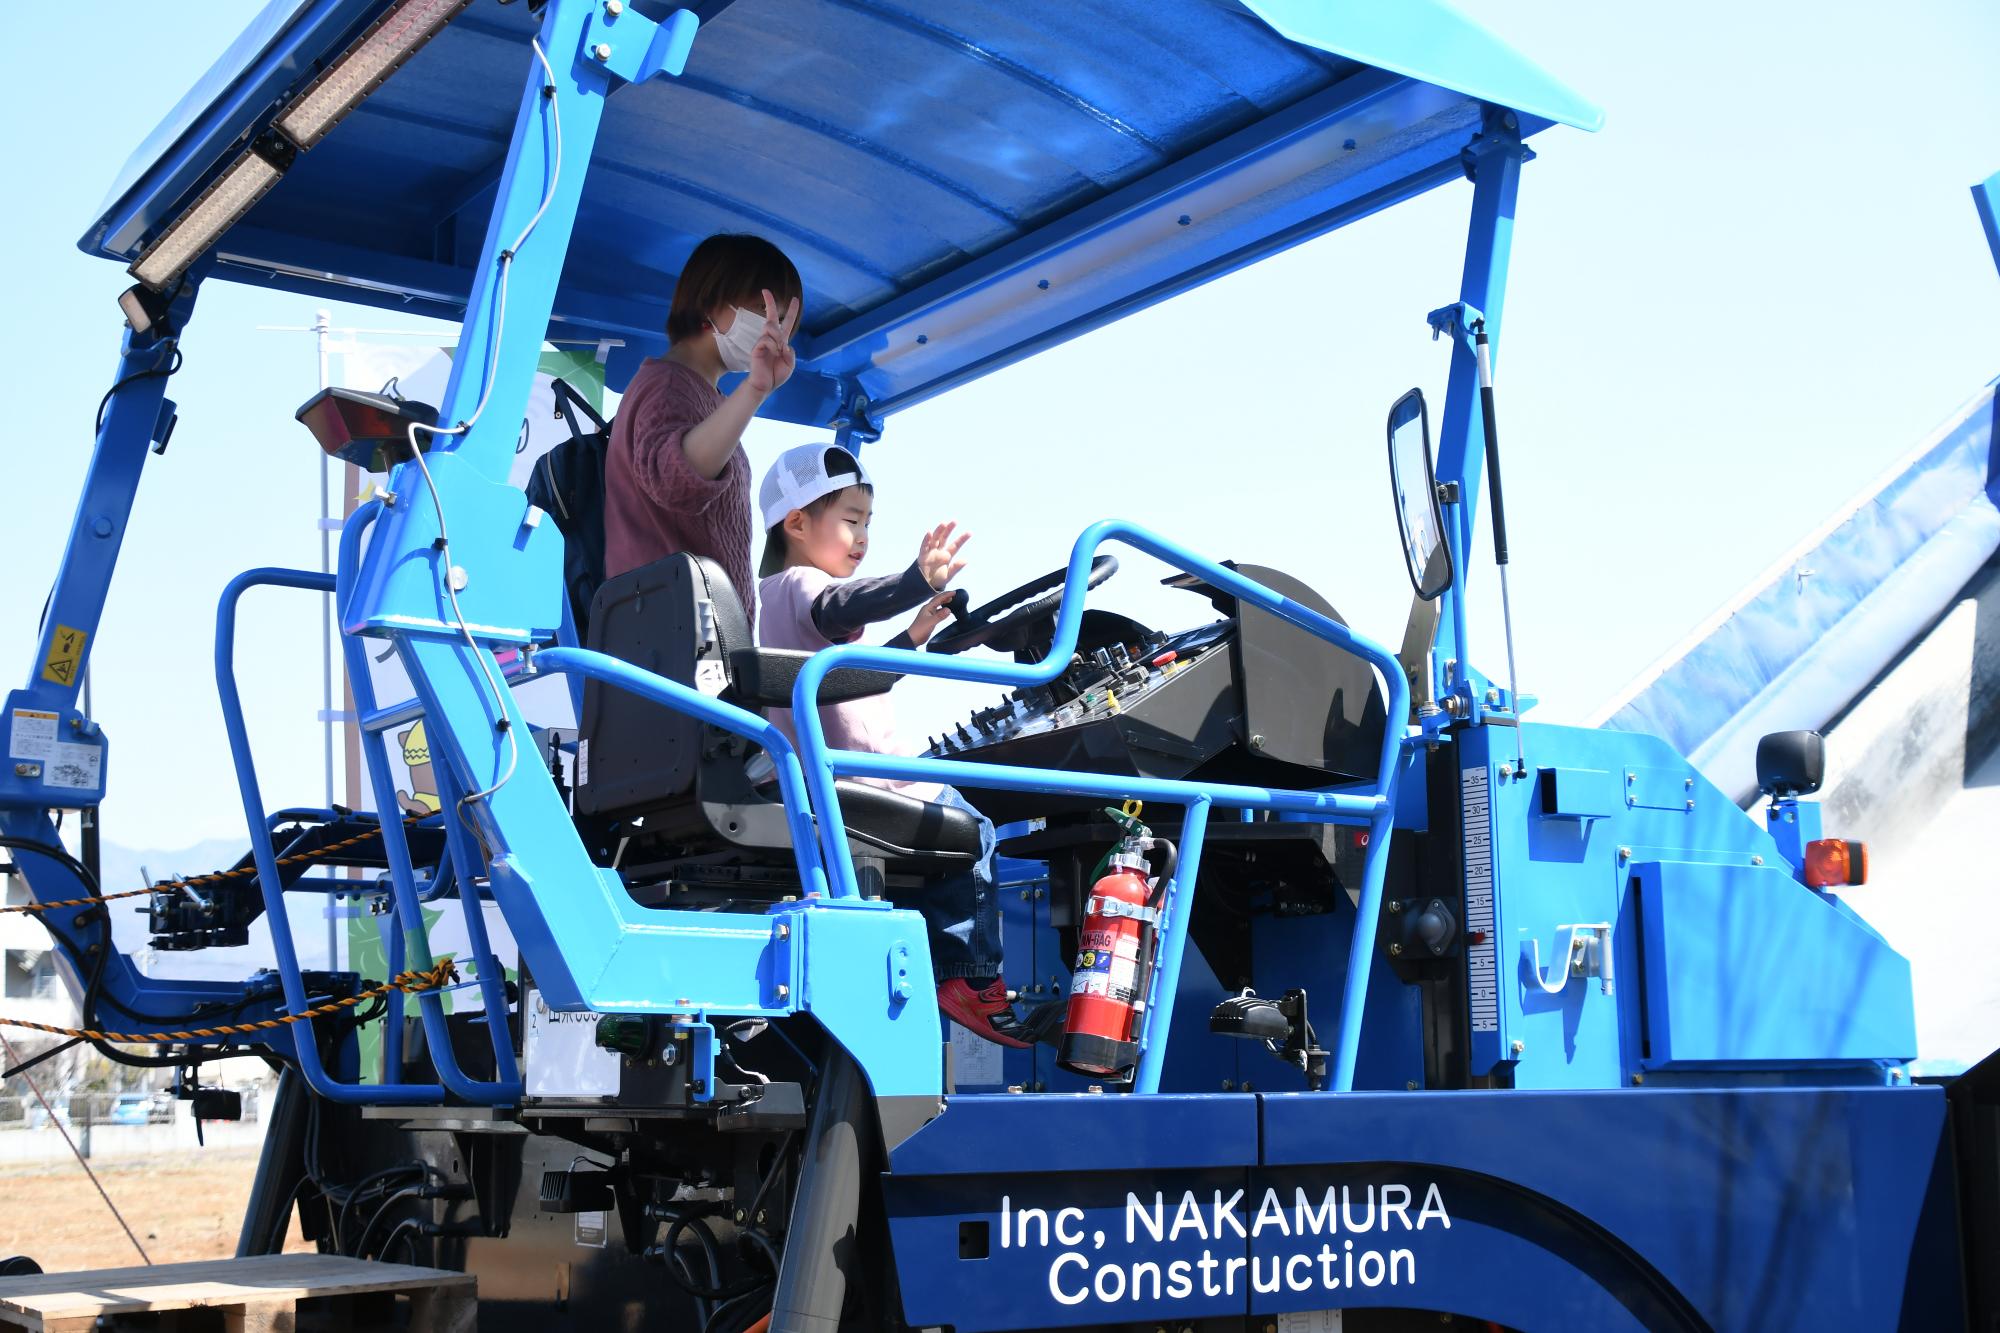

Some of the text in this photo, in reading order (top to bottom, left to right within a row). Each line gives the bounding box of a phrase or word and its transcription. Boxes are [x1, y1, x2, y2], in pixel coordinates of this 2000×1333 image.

[1470, 775, 1480, 784] 35
[1471, 805, 1481, 815] 30
[1473, 836, 1482, 845] 25
[1474, 866, 1484, 875] 20
[1476, 897, 1485, 905] 15
[1480, 958, 1485, 967] 5
[1481, 989, 1486, 998] 0
[1482, 1020, 1487, 1029] 5
[1000, 1182, 1452, 1249] Inc, NAKAMURA
[1048, 1239, 1416, 1305] Construction
